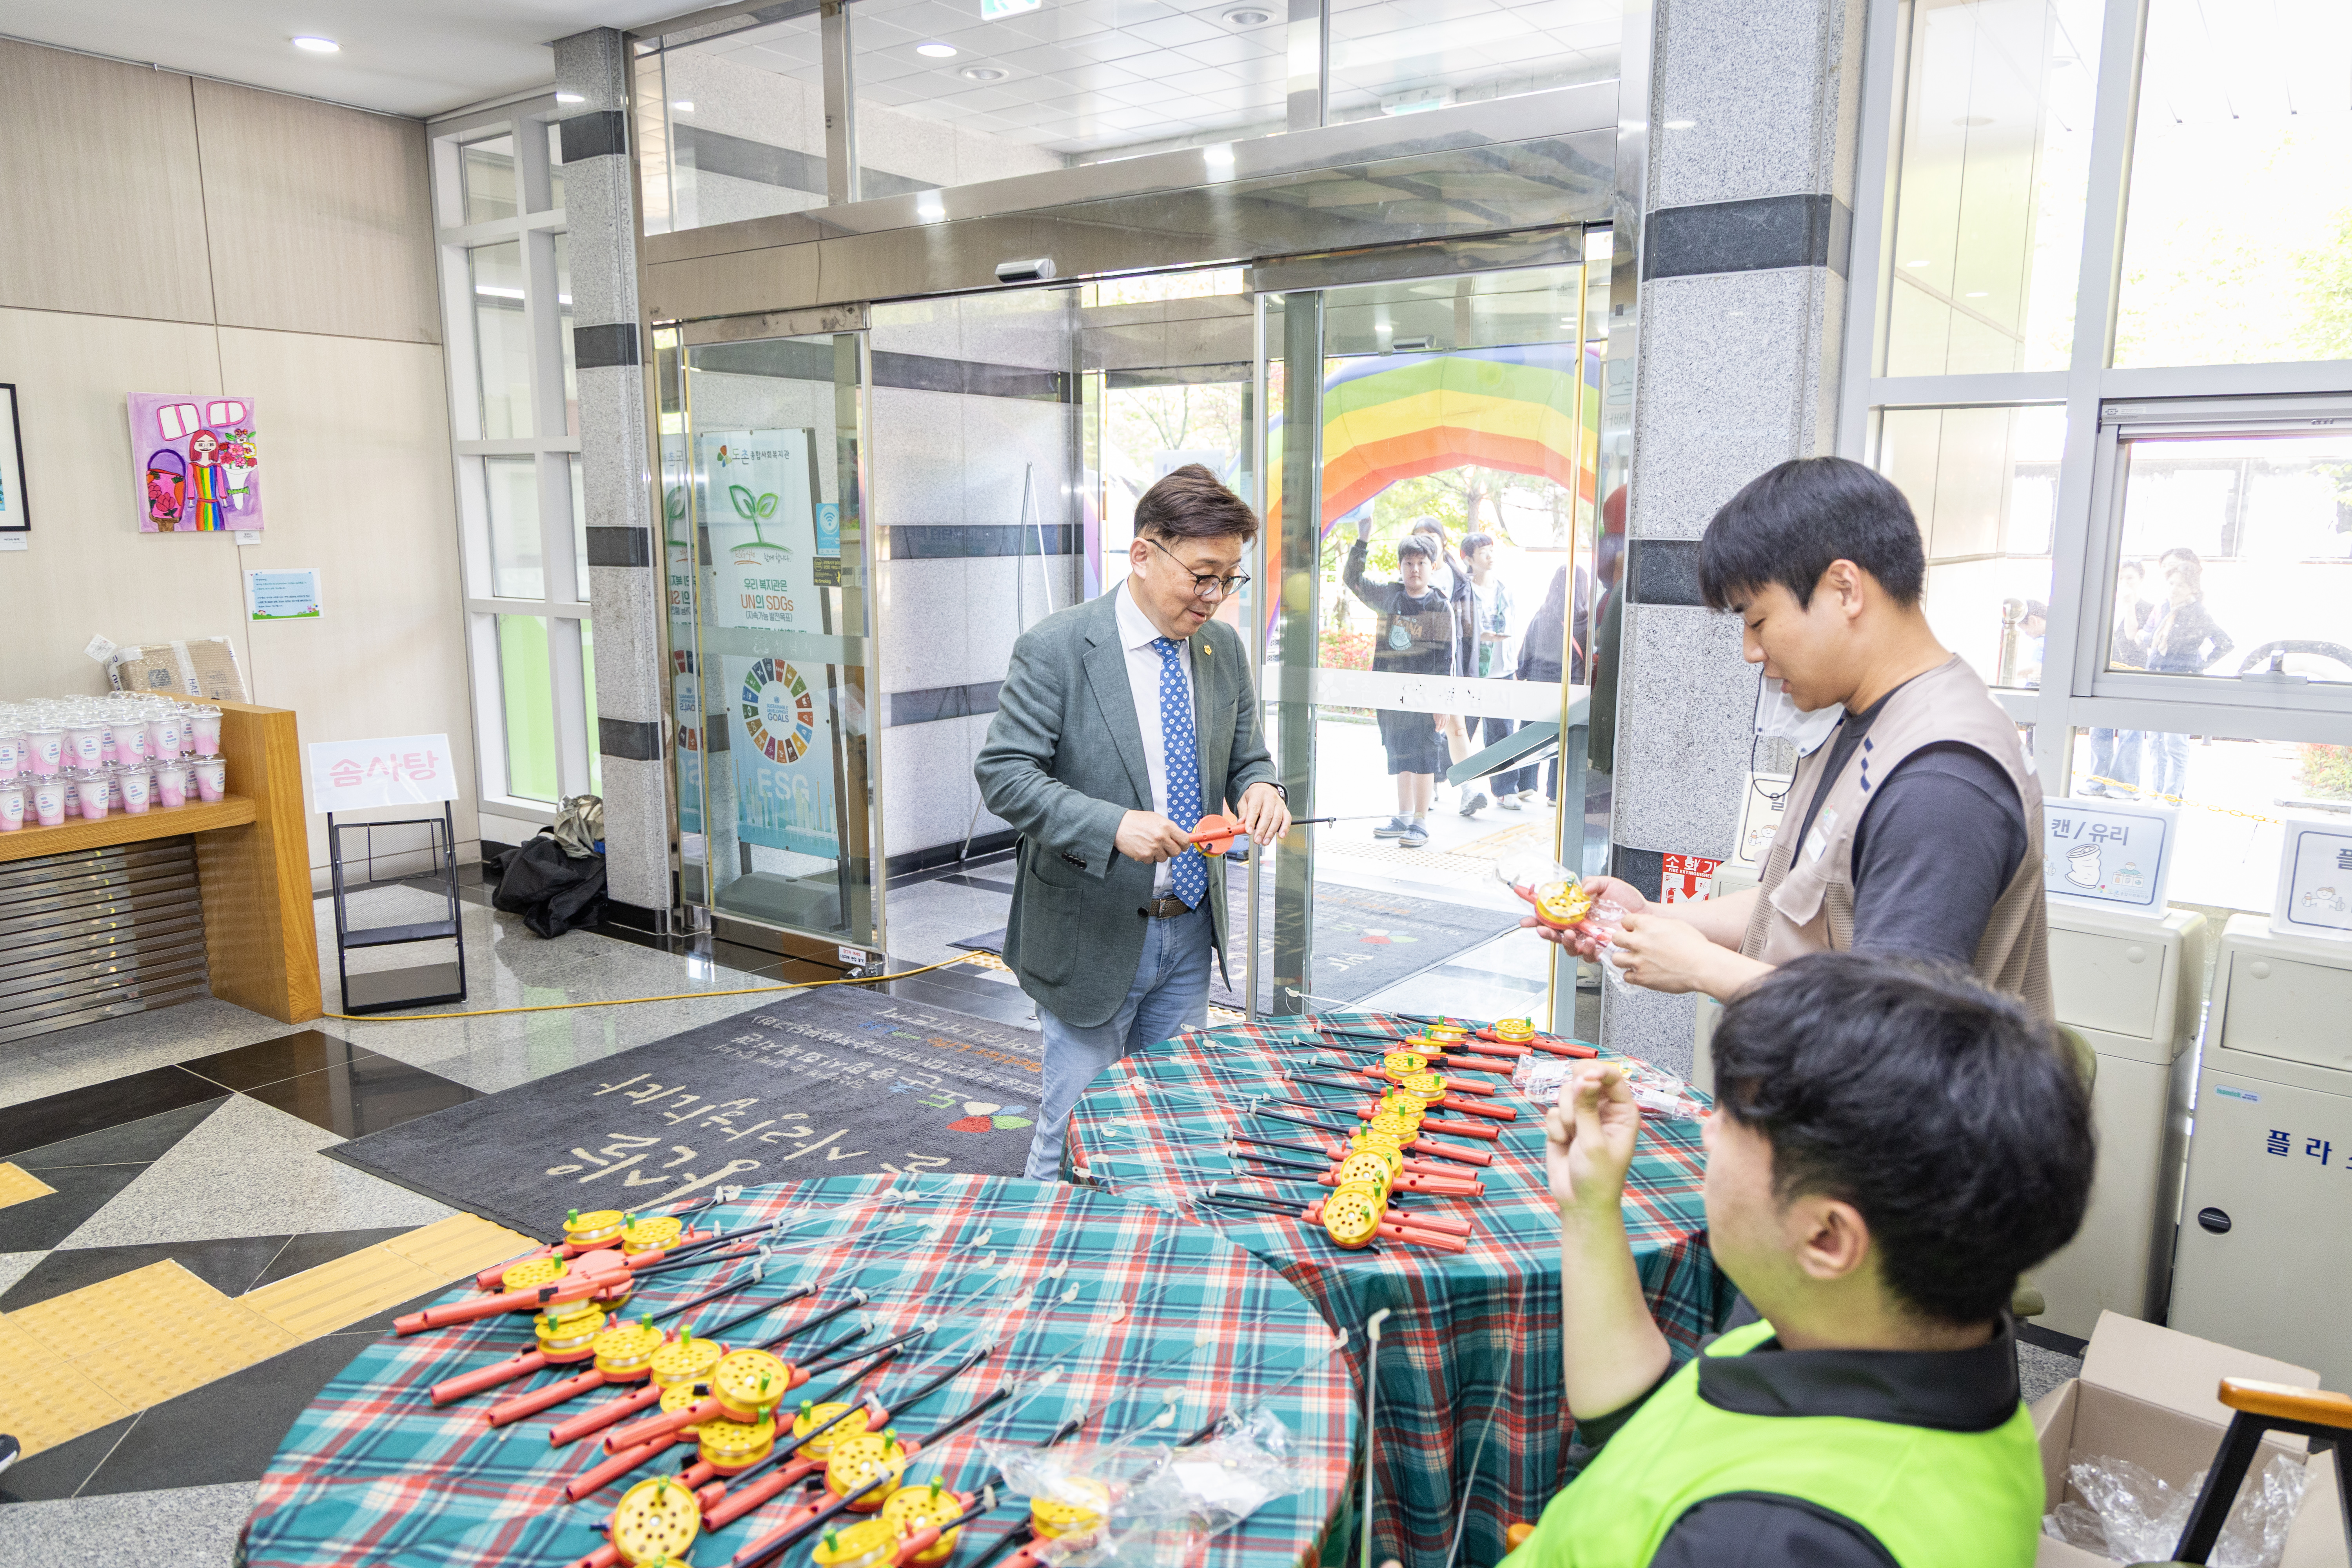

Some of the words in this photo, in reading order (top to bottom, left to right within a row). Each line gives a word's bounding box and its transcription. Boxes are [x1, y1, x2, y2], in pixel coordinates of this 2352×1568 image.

[732, 448, 749, 465] 도촌
[750, 450, 789, 461] 종합사회복지관
[744, 578, 758, 590] 우리
[759, 579, 788, 592] 복지관은
[740, 593, 764, 609] UN의
[766, 595, 794, 611] SDGs
[746, 610, 768, 621] (지속가능
[769, 612, 793, 622] 발전목표)
[768, 713, 789, 722] GOALS
[330, 750, 439, 787] 솜사탕
[757, 768, 810, 801] ESG
[1770, 793, 1786, 812] 일
[2051, 818, 2070, 839] 캔
[2089, 824, 2129, 846] 유리
[1666, 855, 1717, 873] 소화기
[593, 1073, 869, 1161] 사랑합니다
